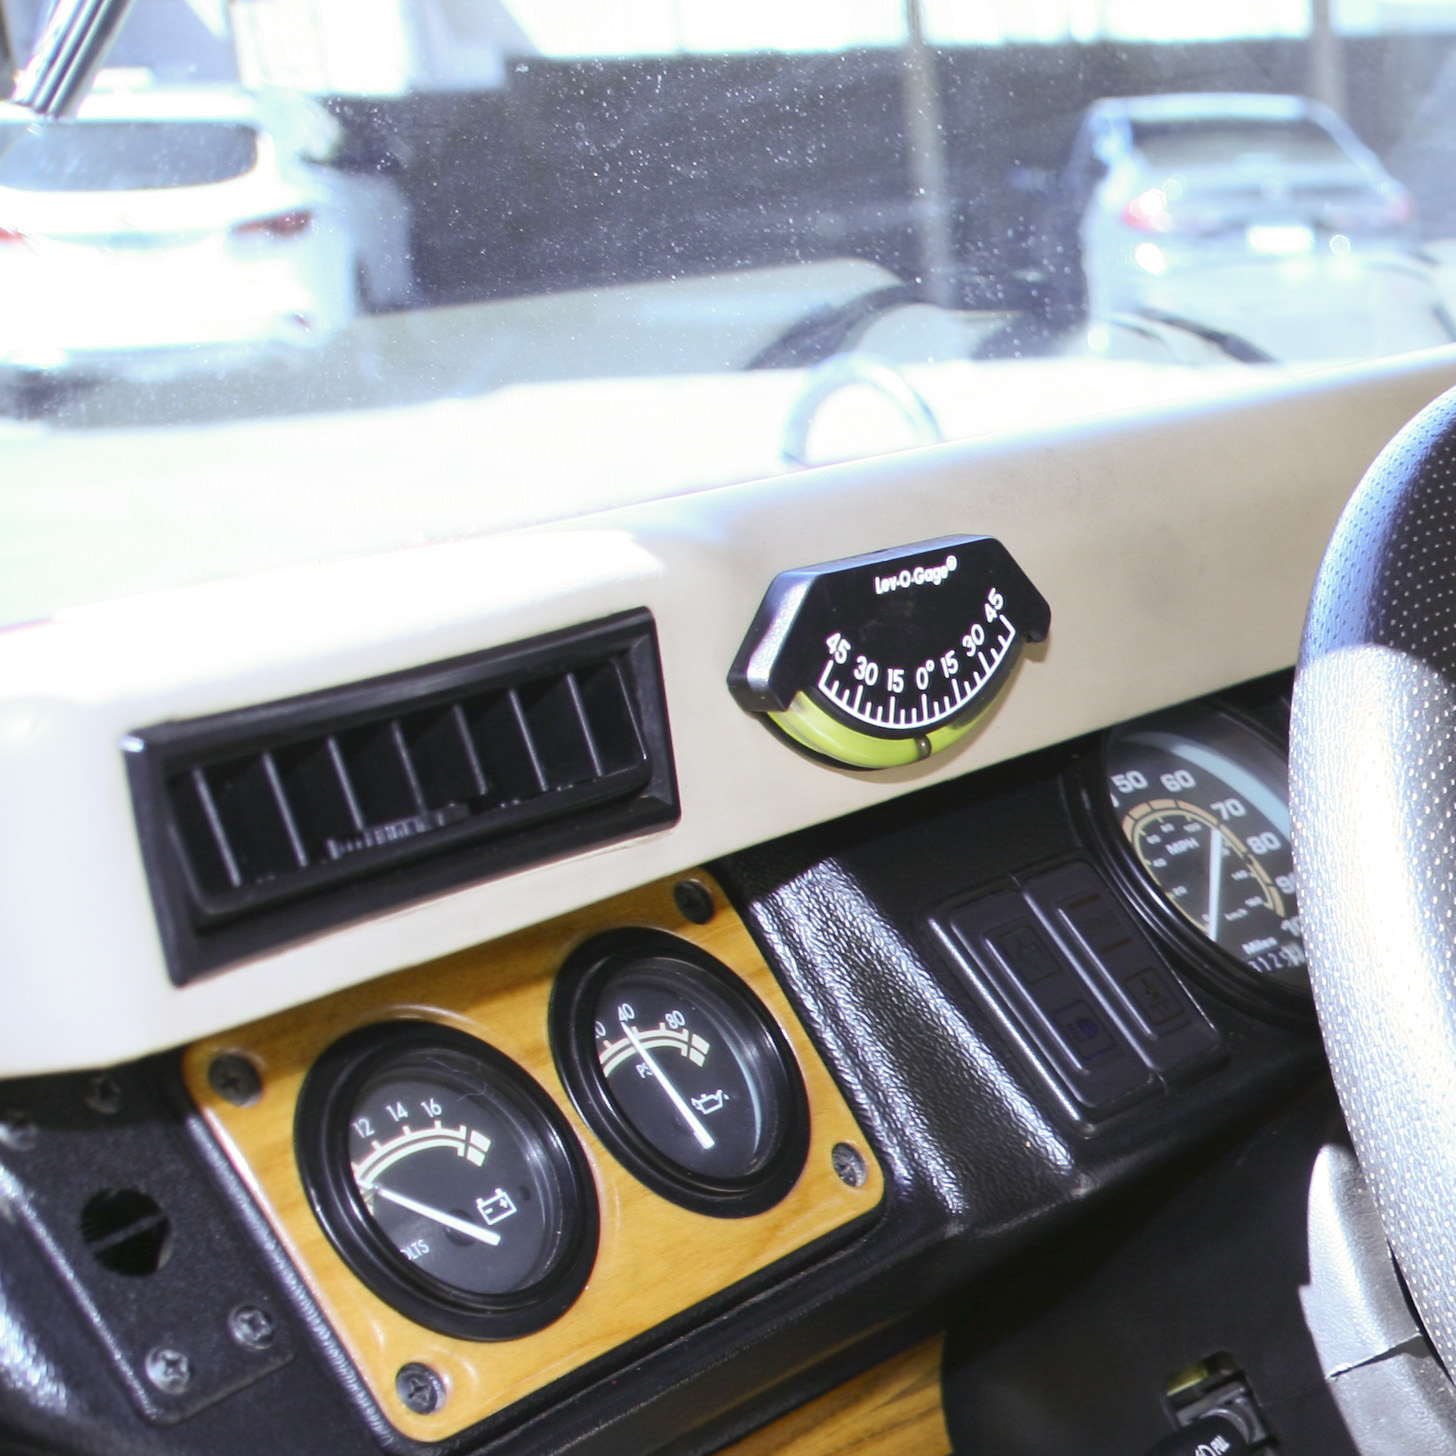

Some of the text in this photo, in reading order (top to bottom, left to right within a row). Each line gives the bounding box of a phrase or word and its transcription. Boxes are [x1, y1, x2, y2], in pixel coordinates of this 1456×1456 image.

[826, 633, 851, 664] 45
[854, 655, 878, 686] 30
[887, 668, 904, 692] 15
[941, 650, 958, 678] 15
[962, 624, 985, 657] 30
[984, 587, 1004, 623] 45
[1111, 770, 1148, 793] 50
[1160, 770, 1196, 792] 60
[1210, 798, 1246, 820] 70
[1246, 832, 1281, 855] 80
[1166, 837, 1200, 855] MPH
[1242, 937, 1277, 955] Miles
[618, 1003, 635, 1021] 40
[665, 1010, 685, 1029] 80
[636, 1062, 653, 1078] PS
[352, 1098, 442, 1138] 12 14 16
